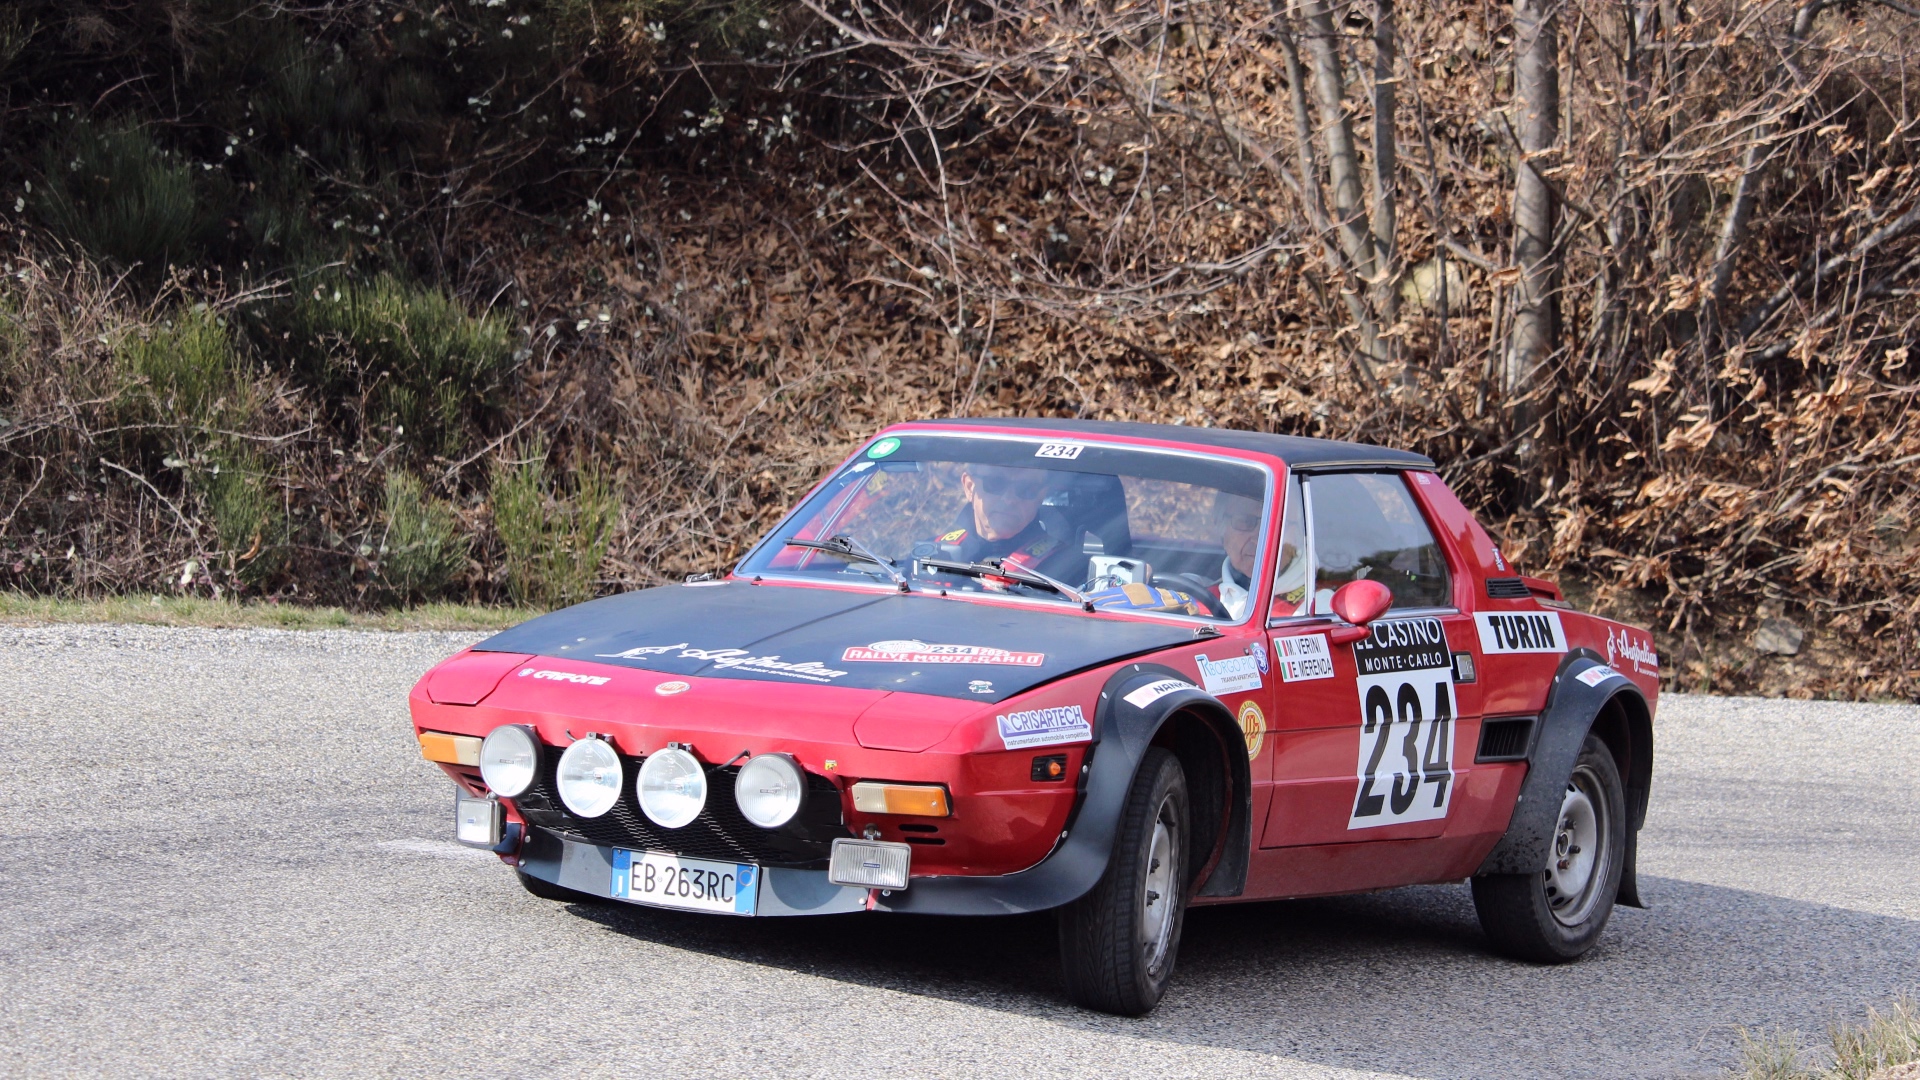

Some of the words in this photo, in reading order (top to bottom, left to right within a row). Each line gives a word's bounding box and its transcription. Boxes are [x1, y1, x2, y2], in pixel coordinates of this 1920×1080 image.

[1040, 445, 1078, 457] 234
[1372, 619, 1441, 649] CASINO
[1487, 615, 1556, 650] TURIN
[849, 649, 909, 661] RALLYE
[931, 646, 973, 654] 234
[1010, 706, 1082, 731] CRISARTECH
[1354, 681, 1451, 817] 234
[631, 861, 656, 893] EB
[664, 866, 734, 903] 263RC
